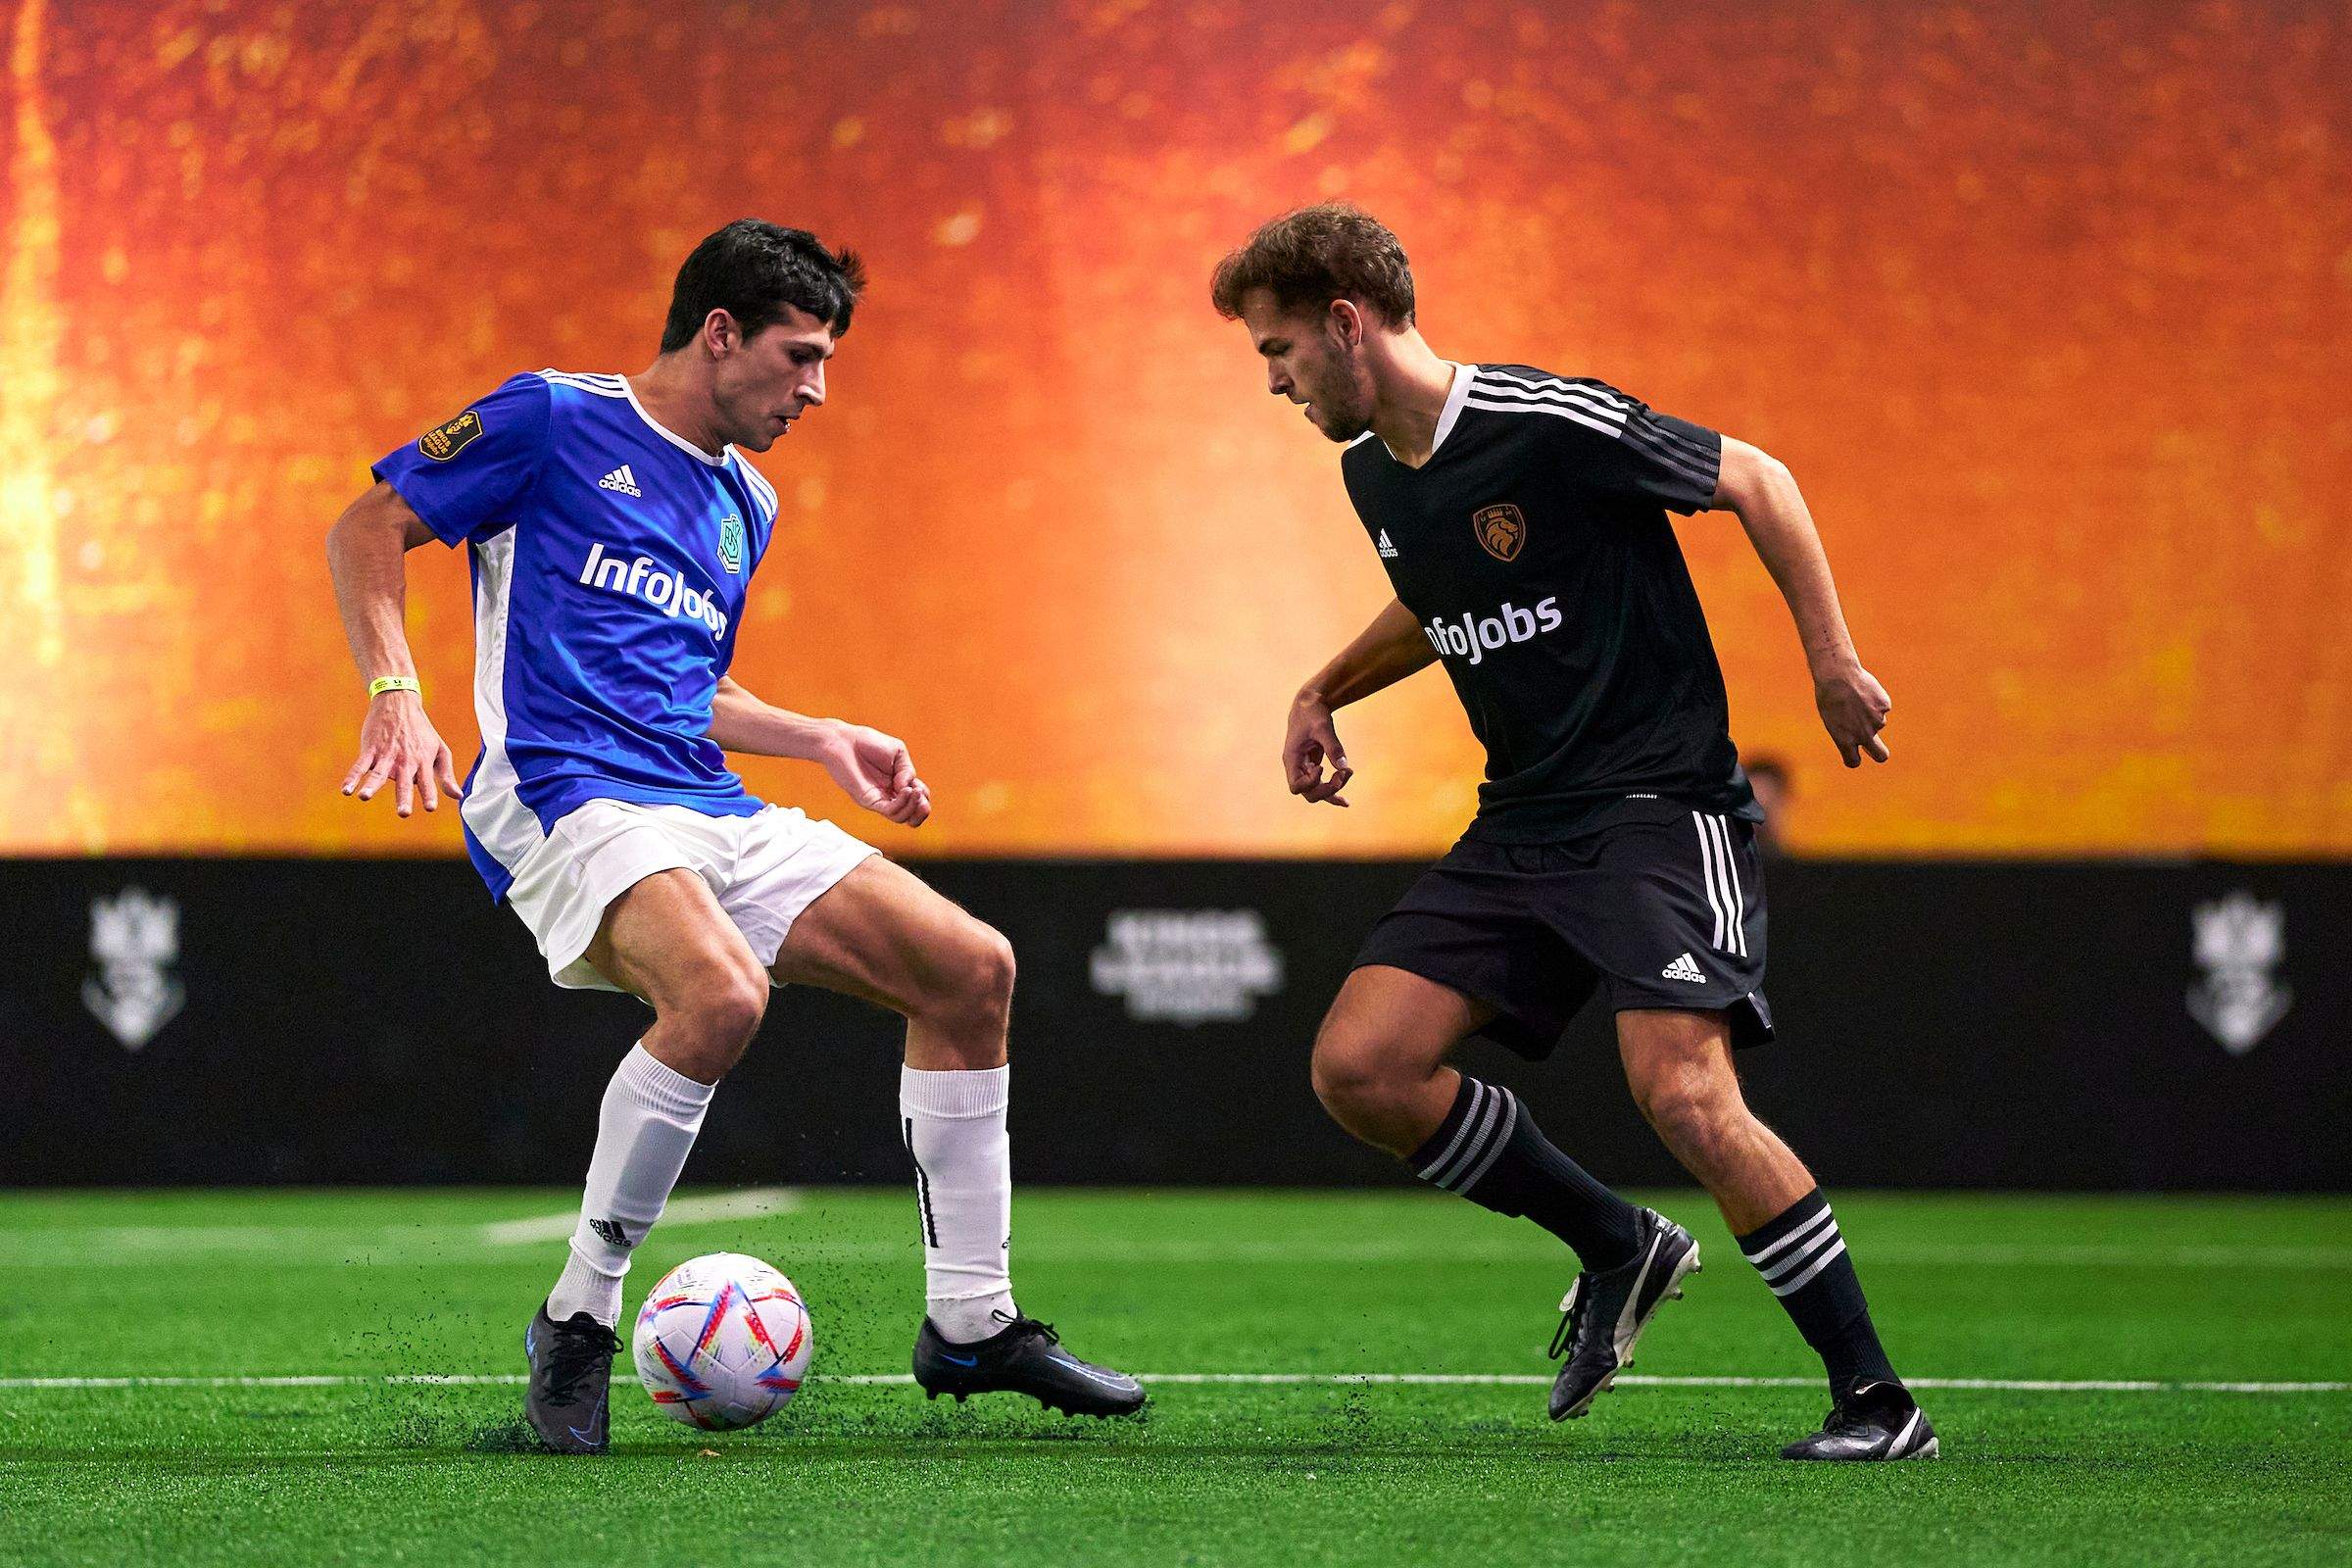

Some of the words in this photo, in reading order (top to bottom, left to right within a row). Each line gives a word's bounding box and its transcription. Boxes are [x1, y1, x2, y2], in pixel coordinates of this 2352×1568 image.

[599, 478, 642, 498] adidas
[579, 543, 728, 641] InfoJobs
[1424, 596, 1562, 664] nfoJobs
[1661, 967, 1707, 984] adidas
[590, 1218, 632, 1248] adidas
